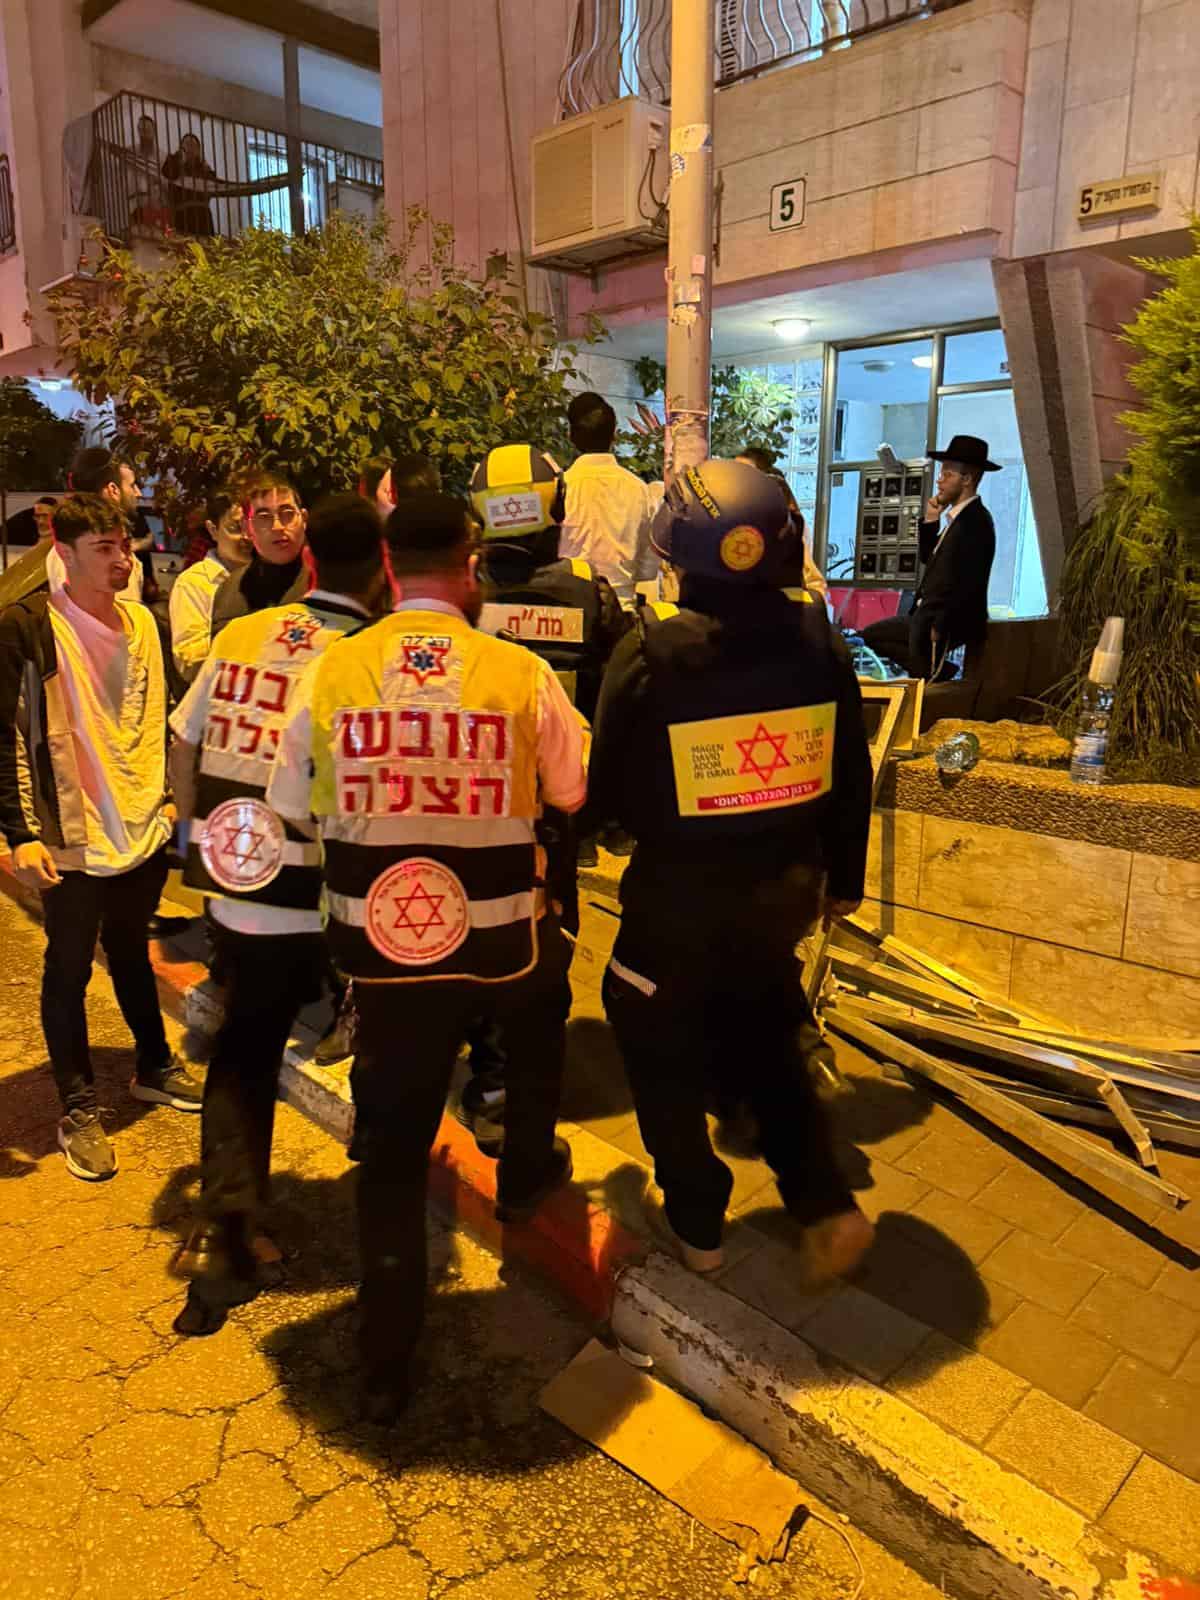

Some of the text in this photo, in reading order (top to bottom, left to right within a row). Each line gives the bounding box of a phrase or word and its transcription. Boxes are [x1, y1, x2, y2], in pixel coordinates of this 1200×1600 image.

[780, 187, 795, 222] 5
[1080, 188, 1093, 214] 5
[342, 711, 506, 761] חובש
[691, 743, 724, 752] MAGEN
[706, 768, 737, 779] ISRAEL
[343, 767, 505, 816] הצלה
[714, 793, 754, 808] הלאומי
